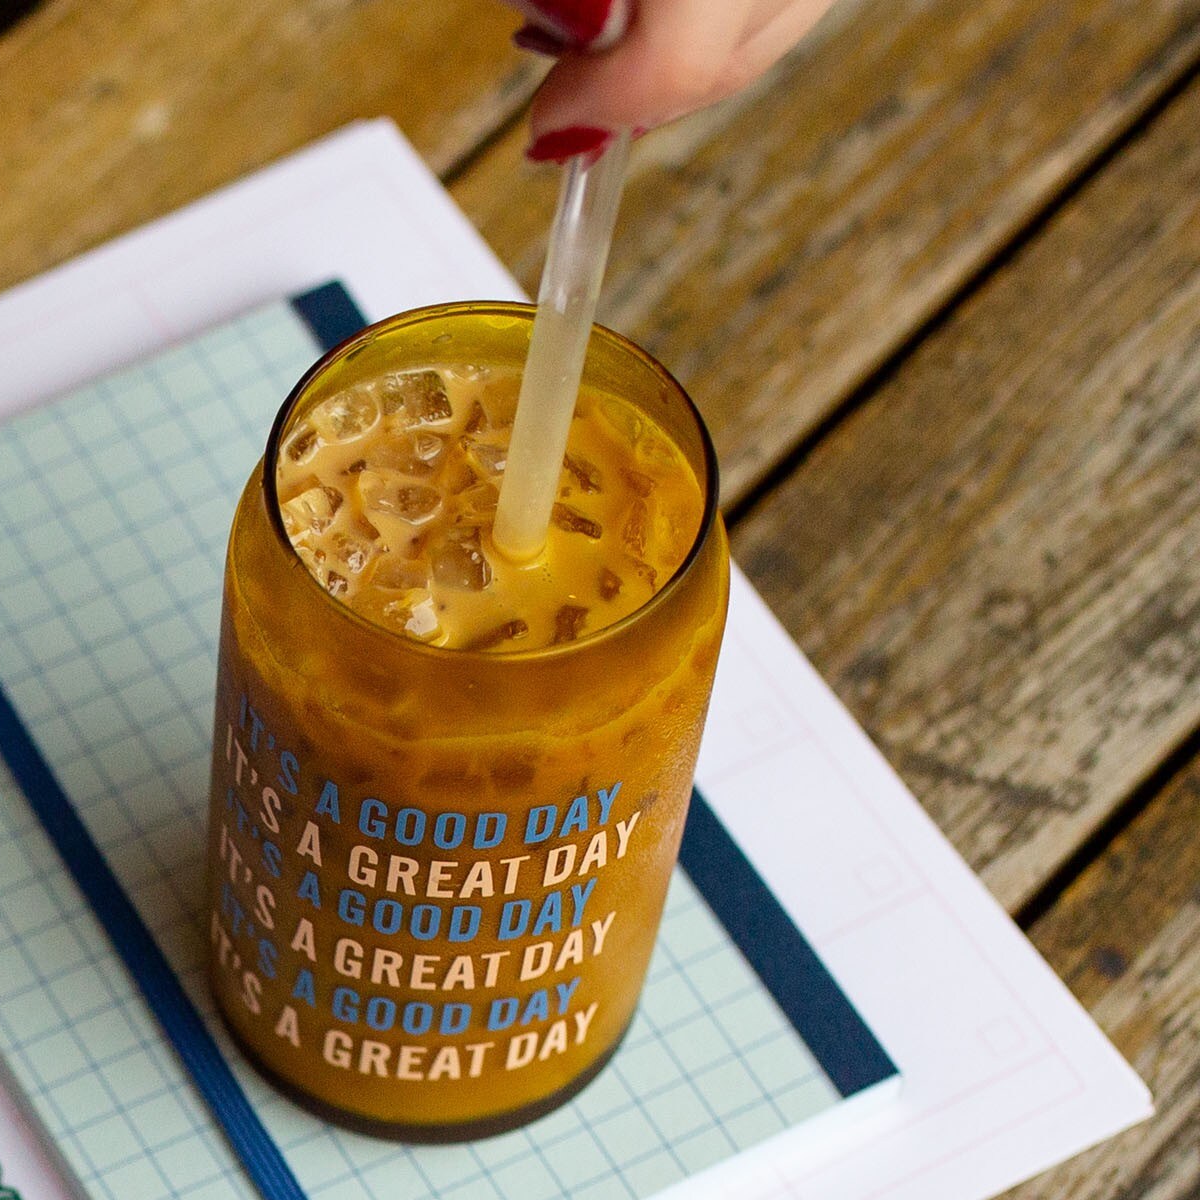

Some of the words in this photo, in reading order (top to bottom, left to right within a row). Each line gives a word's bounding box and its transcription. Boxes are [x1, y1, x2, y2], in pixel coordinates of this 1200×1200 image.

[226, 723, 282, 834] IT'S
[296, 820, 323, 867] A
[348, 845, 531, 899] GREAT
[543, 811, 641, 888] DAY
[238, 693, 300, 796] IT'S
[314, 780, 341, 825] A
[359, 798, 507, 850] GOOD
[524, 782, 622, 844] DAY
[220, 824, 276, 930] IT'S
[291, 918, 317, 962] A
[333, 937, 510, 991] GREAT
[519, 912, 616, 982] DAY
[297, 871, 321, 910] A
[337, 888, 482, 943] GOOD
[498, 878, 597, 941] DAY
[275, 1005, 300, 1048] A
[322, 1030, 495, 1082] GREAT
[506, 1002, 599, 1071] DAY
[292, 968, 316, 1008] A
[331, 987, 473, 1036] GOOD
[487, 978, 582, 1033] DAY
